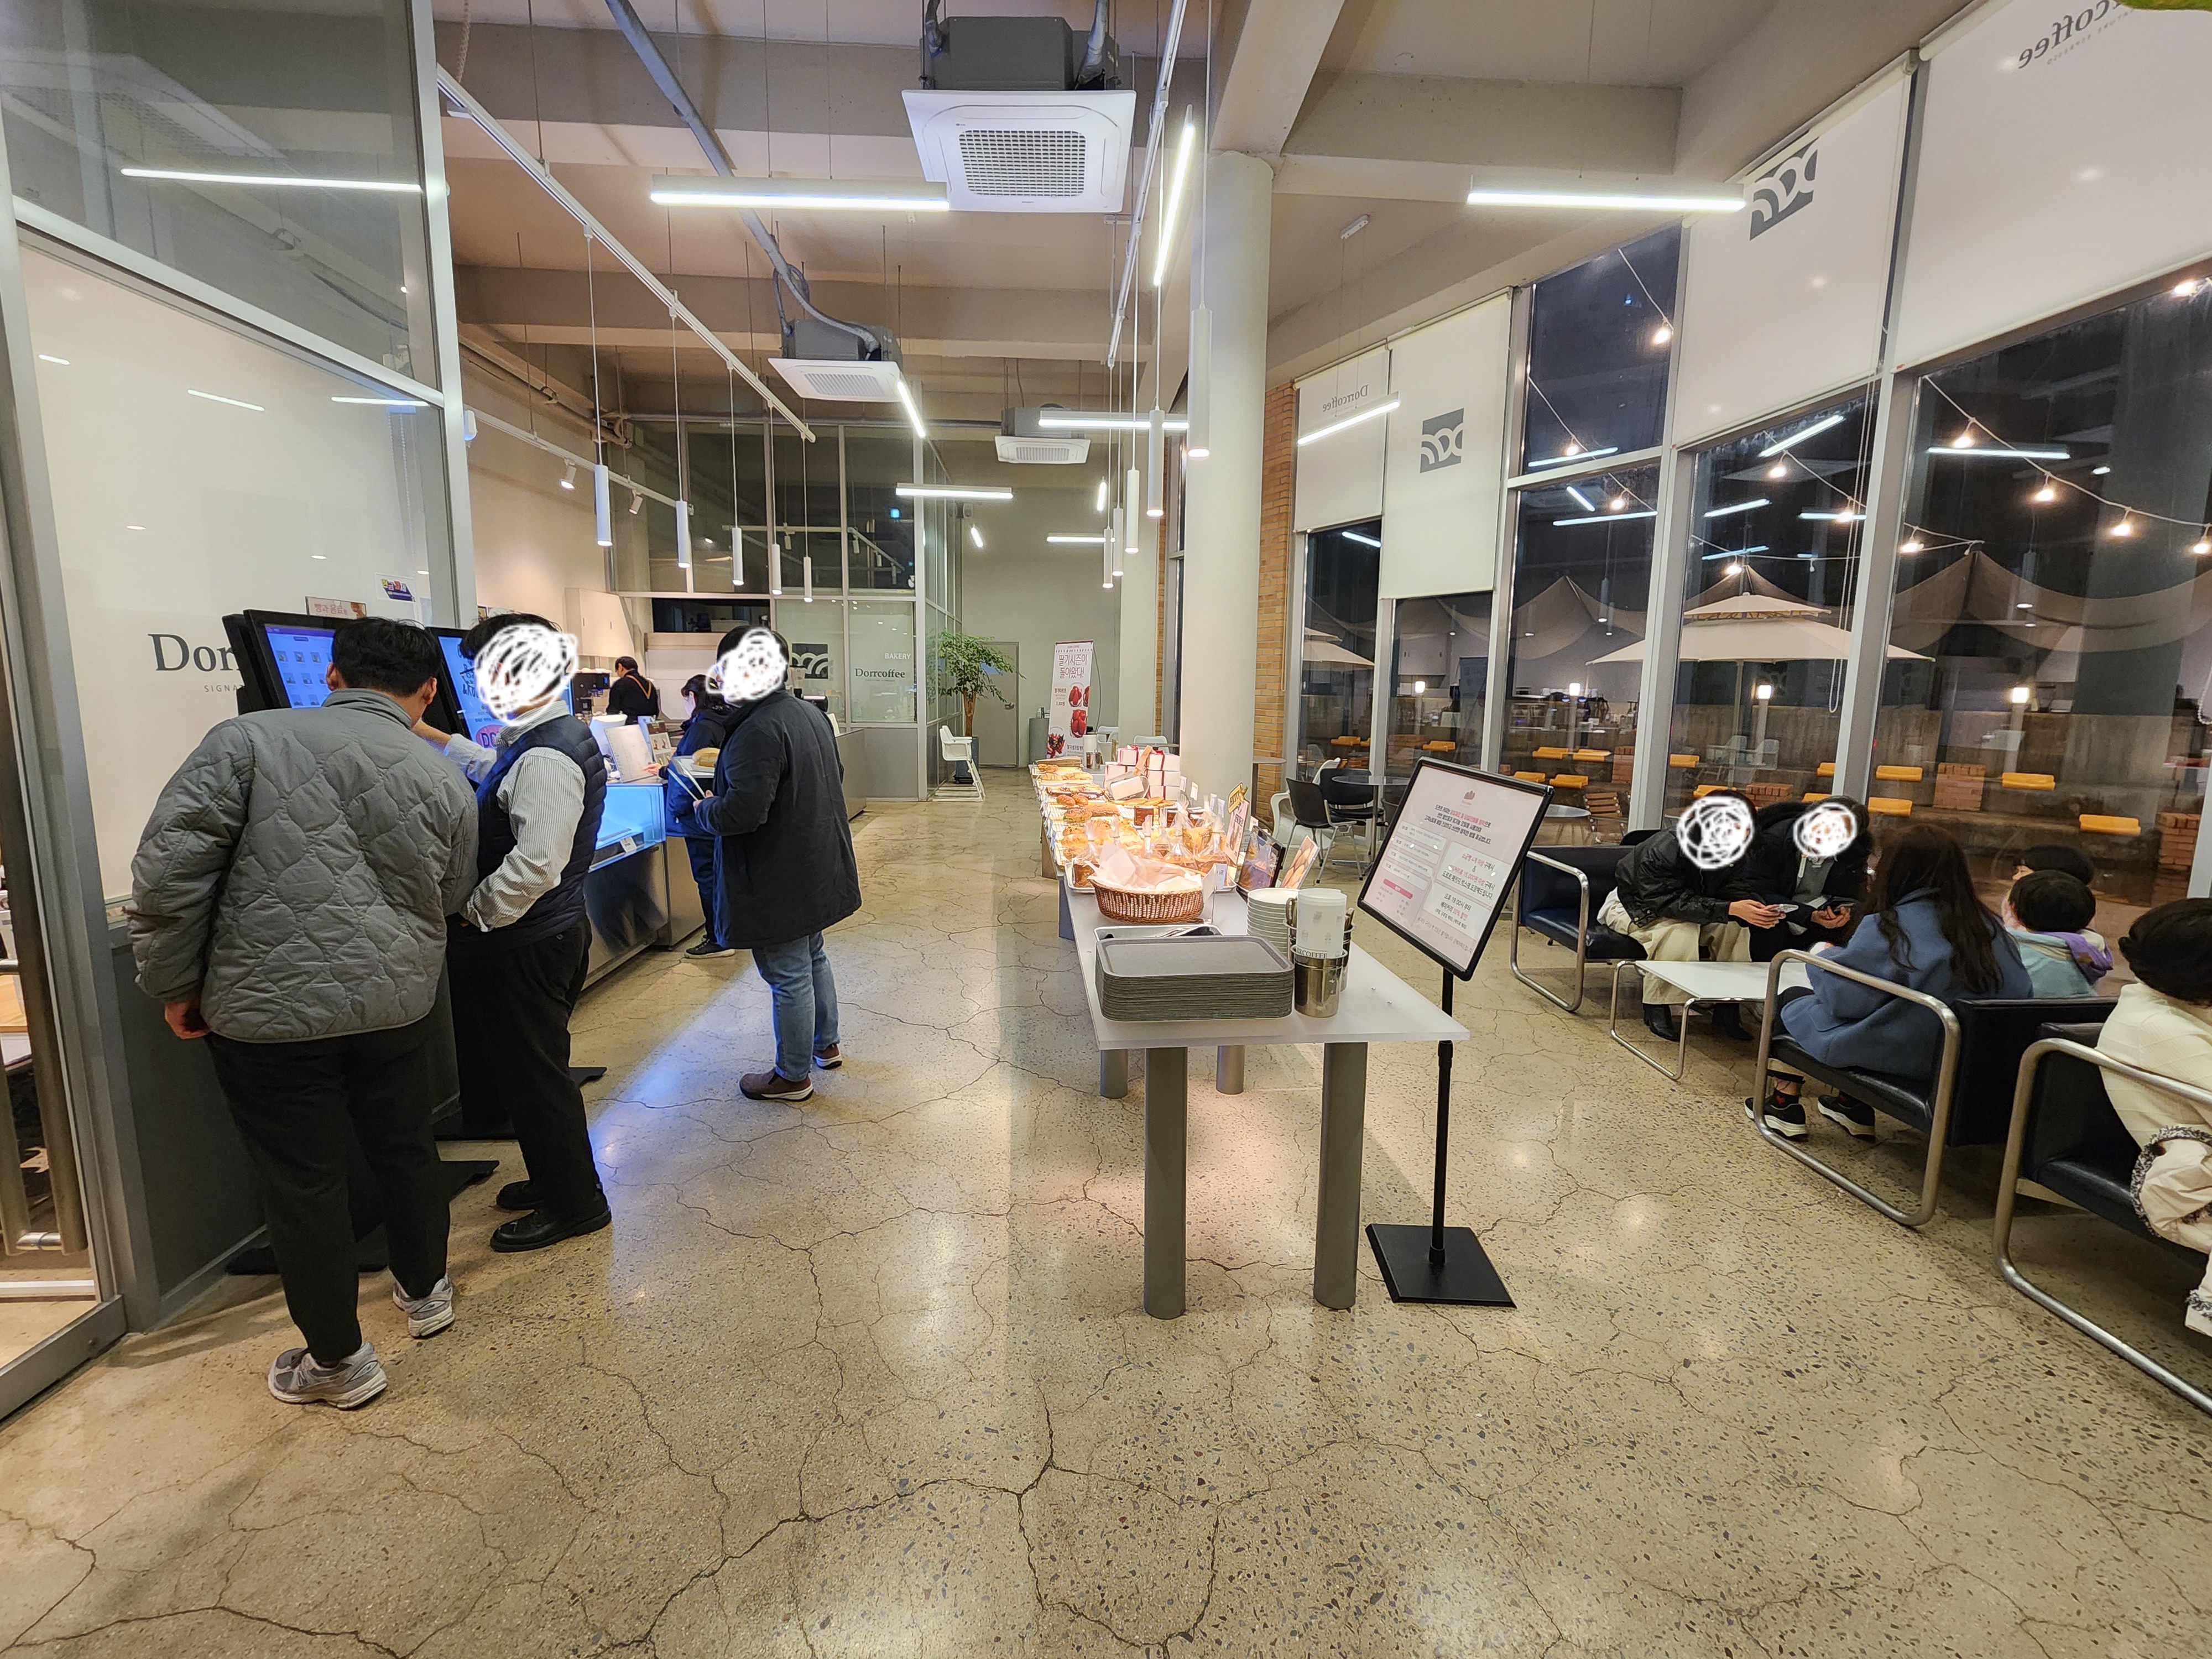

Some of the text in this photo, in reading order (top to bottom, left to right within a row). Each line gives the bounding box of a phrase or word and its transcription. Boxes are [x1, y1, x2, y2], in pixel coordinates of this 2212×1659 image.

[148, 634, 240, 672] Dor
[1059, 654, 1087, 666] 딸기시즌이
[855, 668, 905, 678] Dorrcoffee
[1484, 862, 1495, 871] 구매시
[1484, 881, 1495, 891] 구매시
[1444, 893, 1452, 901] 오후
[1441, 901, 1453, 912] 베이커리
